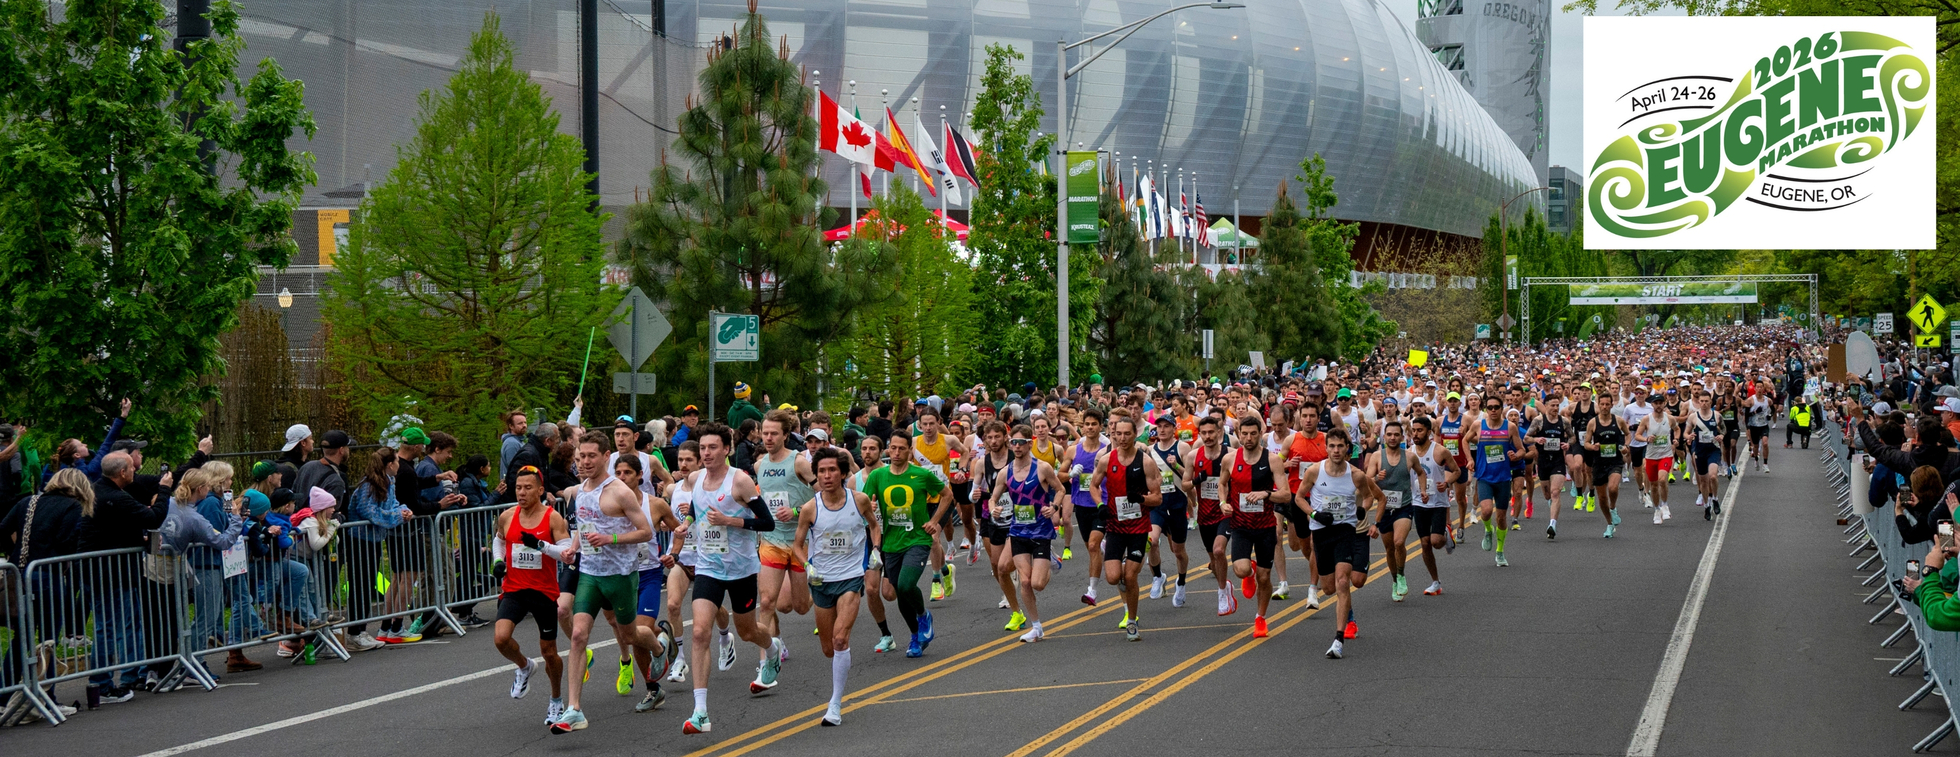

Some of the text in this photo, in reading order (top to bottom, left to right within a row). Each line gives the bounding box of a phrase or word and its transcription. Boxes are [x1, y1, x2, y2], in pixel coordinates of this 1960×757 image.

[1483, 2, 1536, 30] OREGON
[1642, 285, 1682, 297] START
[749, 317, 756, 329] 5
[1879, 321, 1892, 330] 25
[763, 469, 786, 477] HOKA
[883, 484, 914, 508] O
[769, 499, 784, 507] 8334
[704, 530, 721, 539] 3100
[829, 538, 846, 546] 3121
[518, 552, 535, 561] 3113
